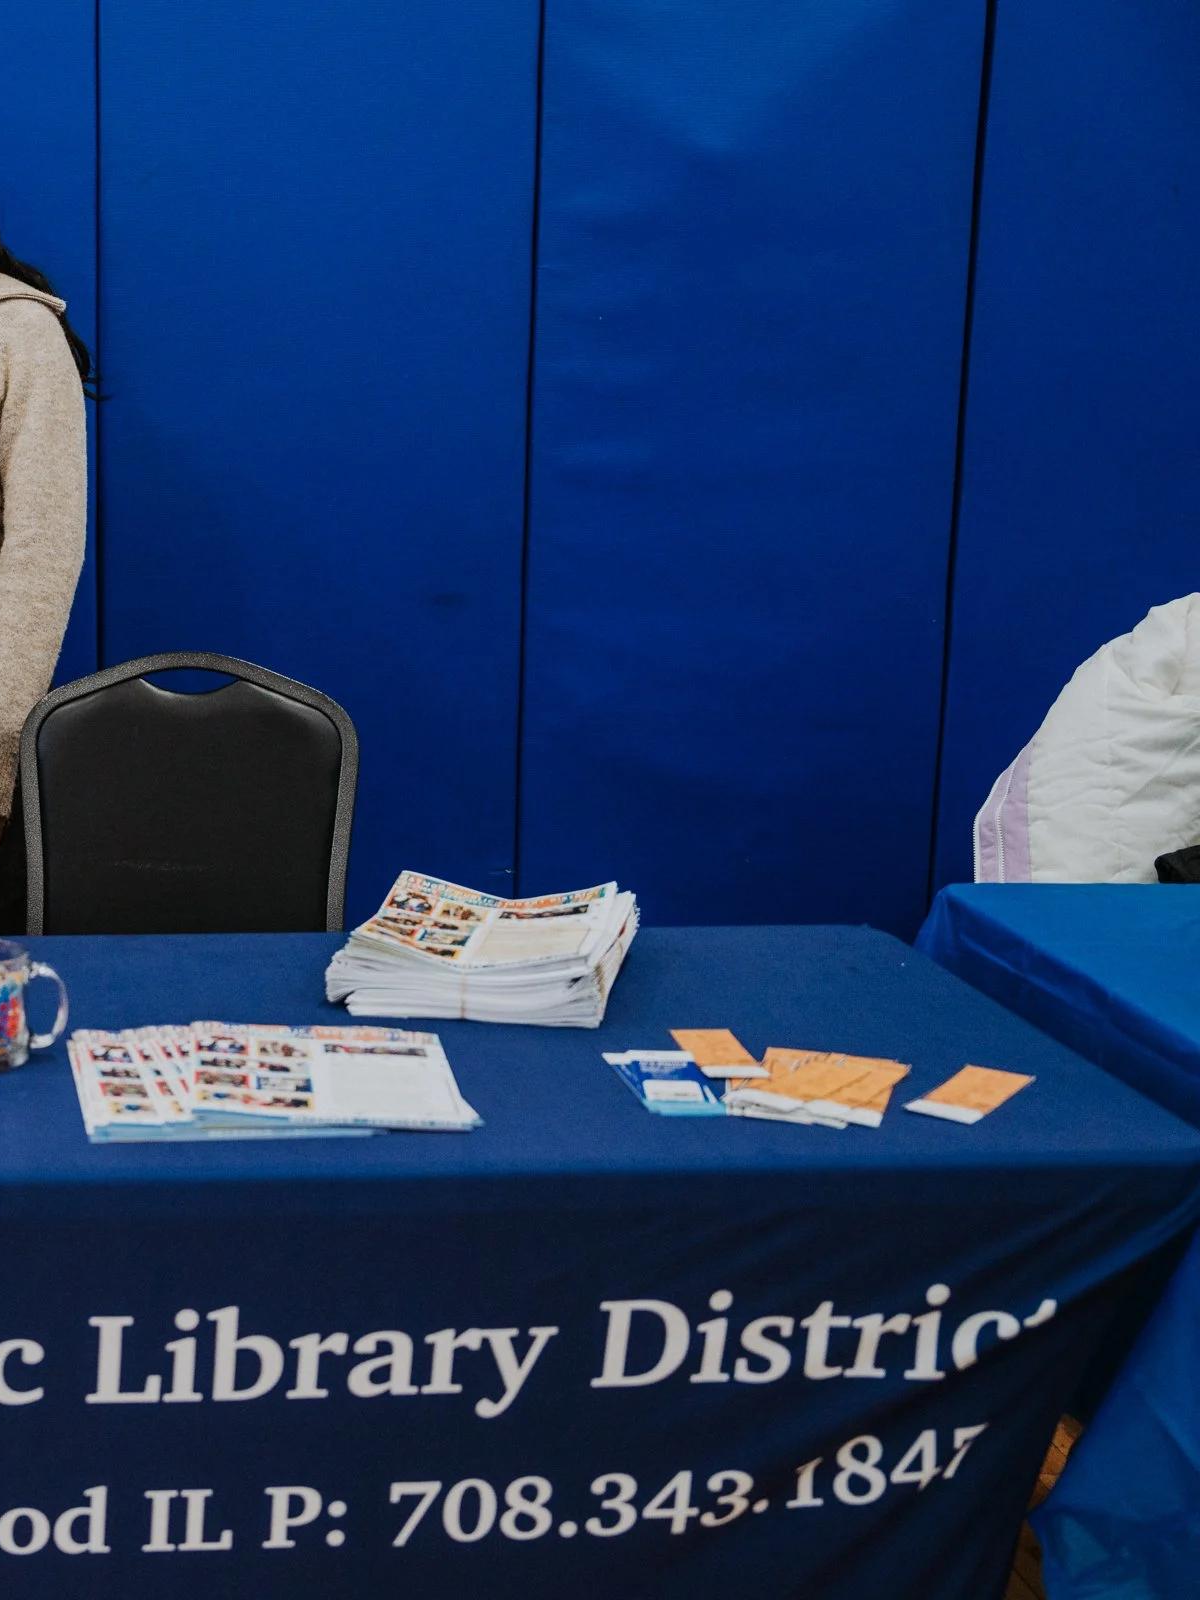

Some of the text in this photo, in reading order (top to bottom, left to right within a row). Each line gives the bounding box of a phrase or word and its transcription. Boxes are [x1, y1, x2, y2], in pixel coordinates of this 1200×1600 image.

[85, 1306, 559, 1418] Library
[590, 1284, 1058, 1388] Distric
[142, 1489, 233, 1552] IL
[262, 1486, 347, 1549] P:
[389, 1423, 989, 1547] 708.343.1847
